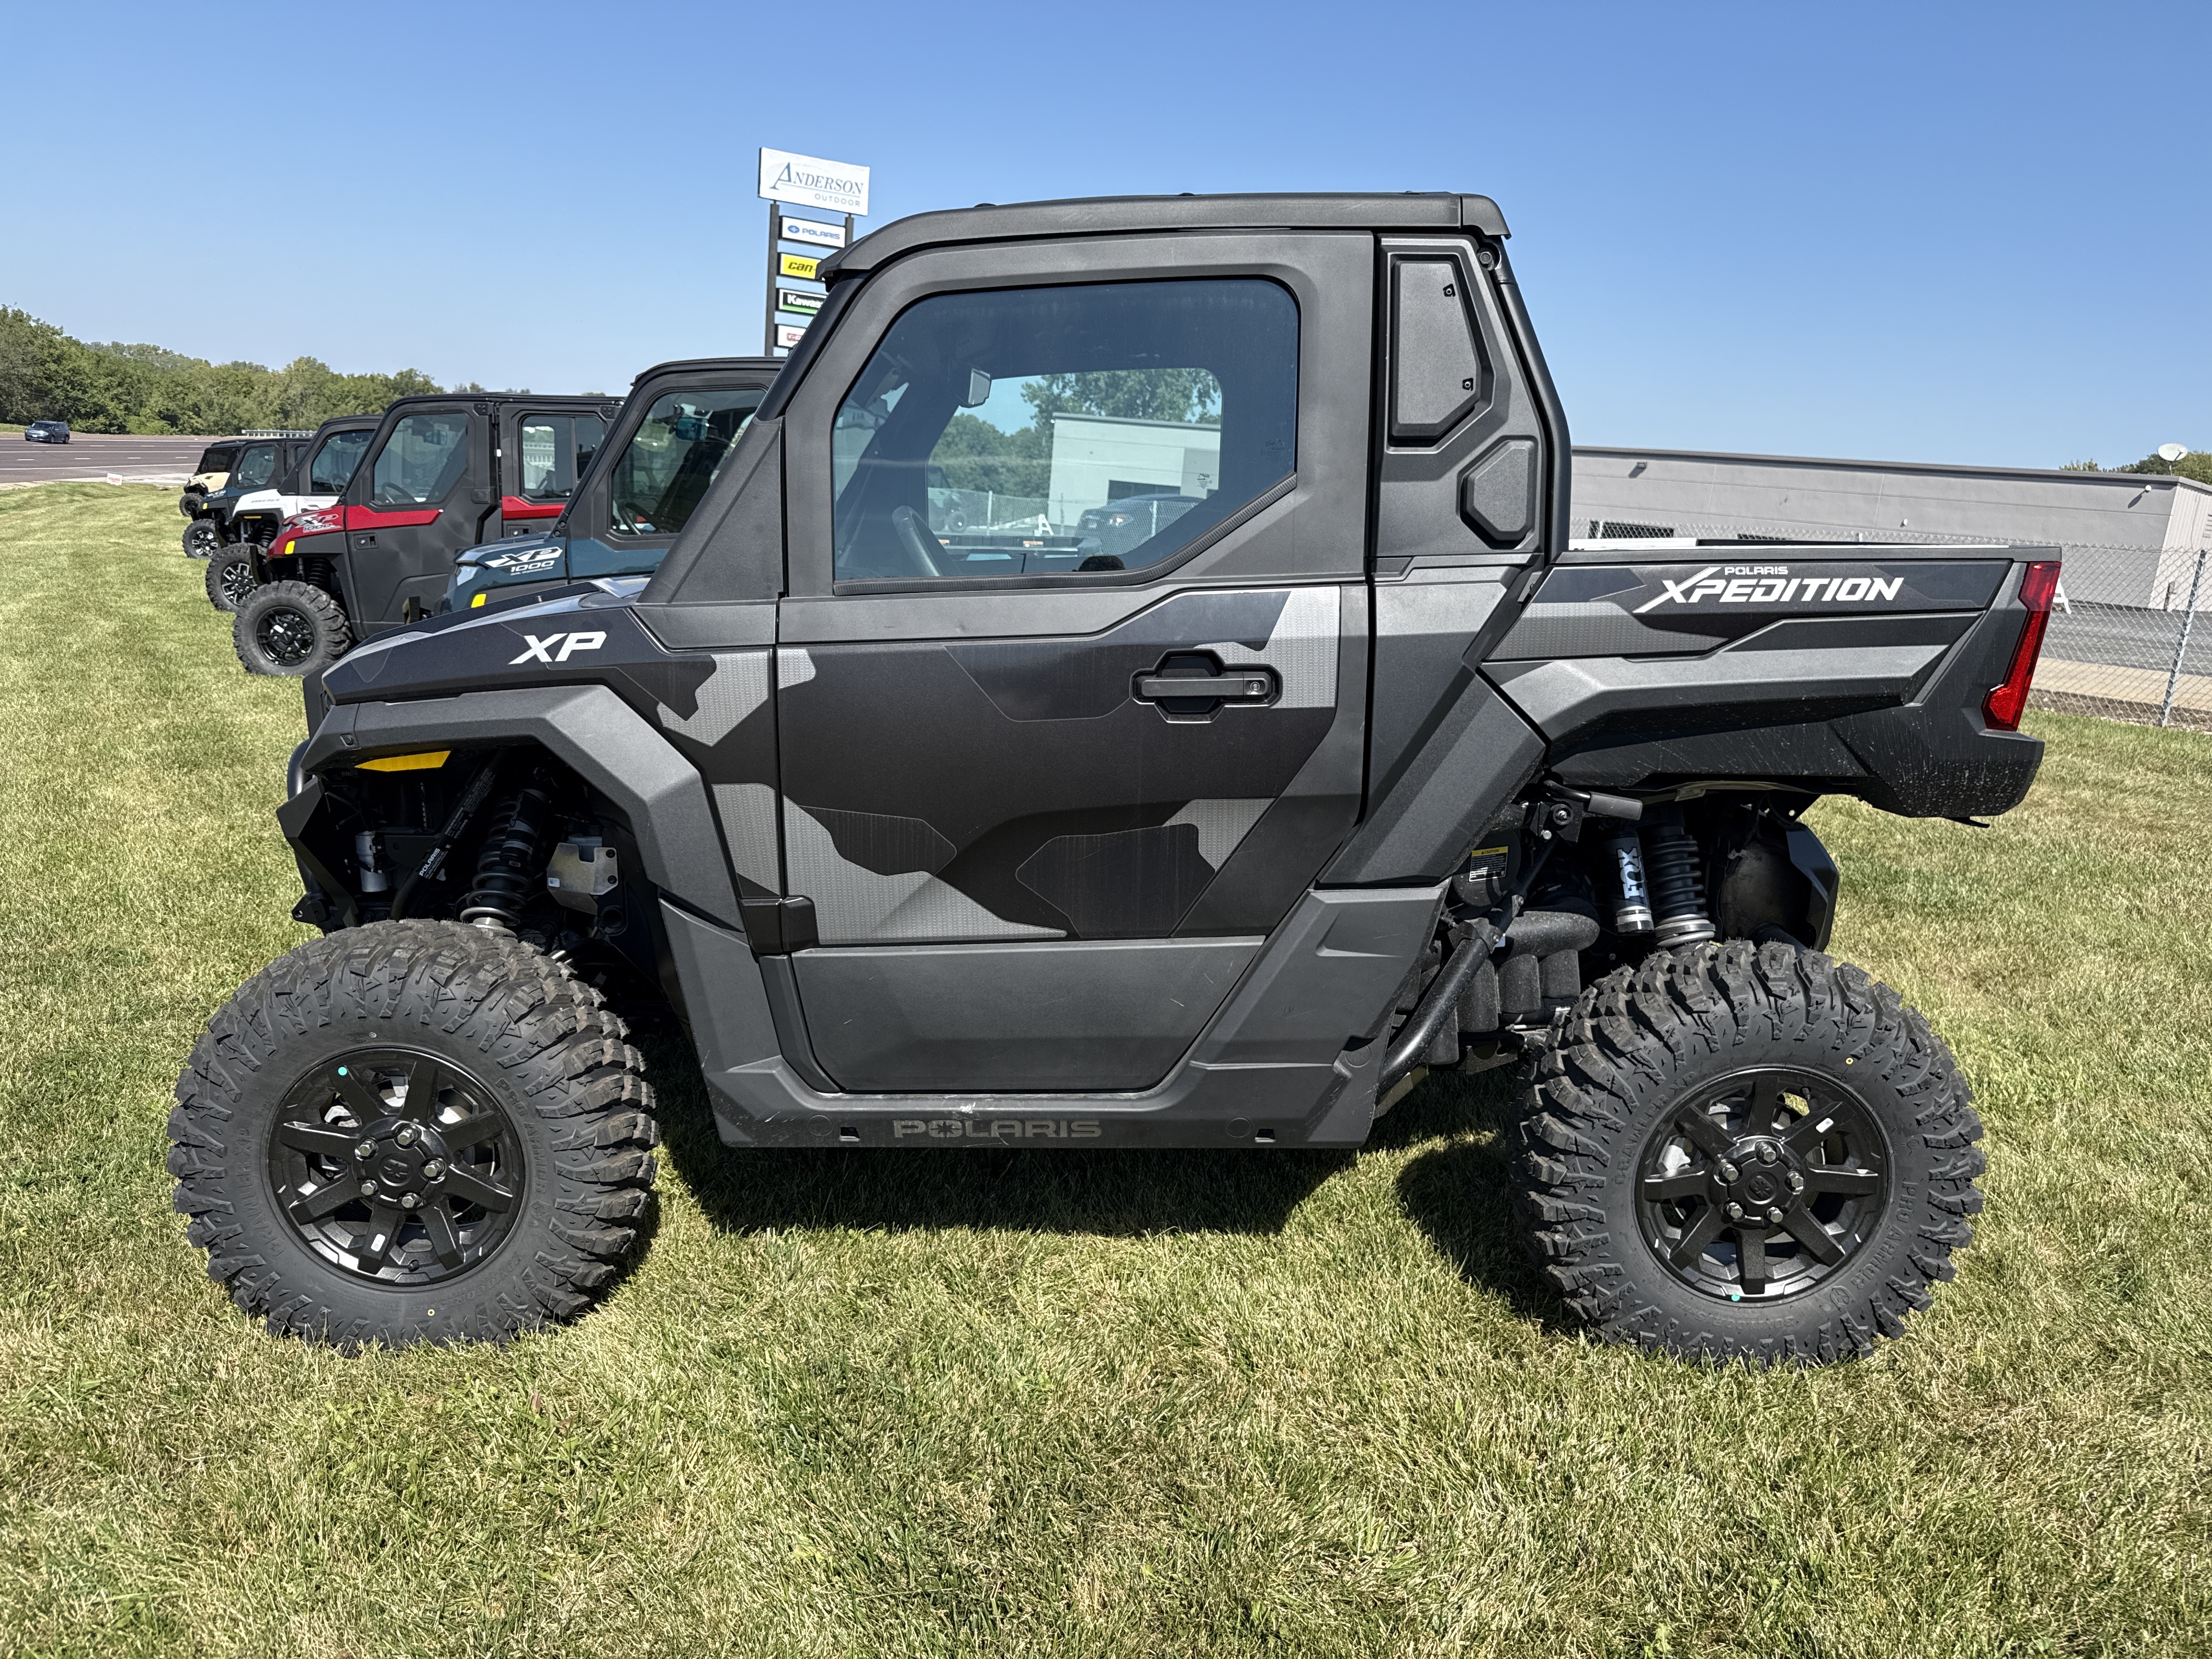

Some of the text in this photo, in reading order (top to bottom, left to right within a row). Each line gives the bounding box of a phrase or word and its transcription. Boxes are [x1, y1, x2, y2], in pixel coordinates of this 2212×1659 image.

[769, 161, 864, 195] ANDERSON
[814, 193, 860, 207] OUTDOOR
[802, 228, 840, 240] POLARIS
[787, 294, 823, 308] Kawas
[300, 514, 338, 526] XP
[304, 523, 334, 532] 1000
[495, 548, 562, 566] XP
[510, 560, 555, 573] 1000
[1724, 566, 1788, 575] POLARIS
[1632, 566, 1905, 613] XPEDITION
[508, 631, 607, 665] XP
[419, 848, 441, 876] POLARIS
[1617, 847, 1645, 899] FOX
[495, 1077, 548, 1194] PRO ARMOR
[893, 1120, 1102, 1137] POLARIS
[1615, 1071, 1696, 1185] CRAWLER XP
[235, 1128, 285, 1257] CRAWLER XP
[1850, 1181, 1918, 1290] PRO ARMOR
